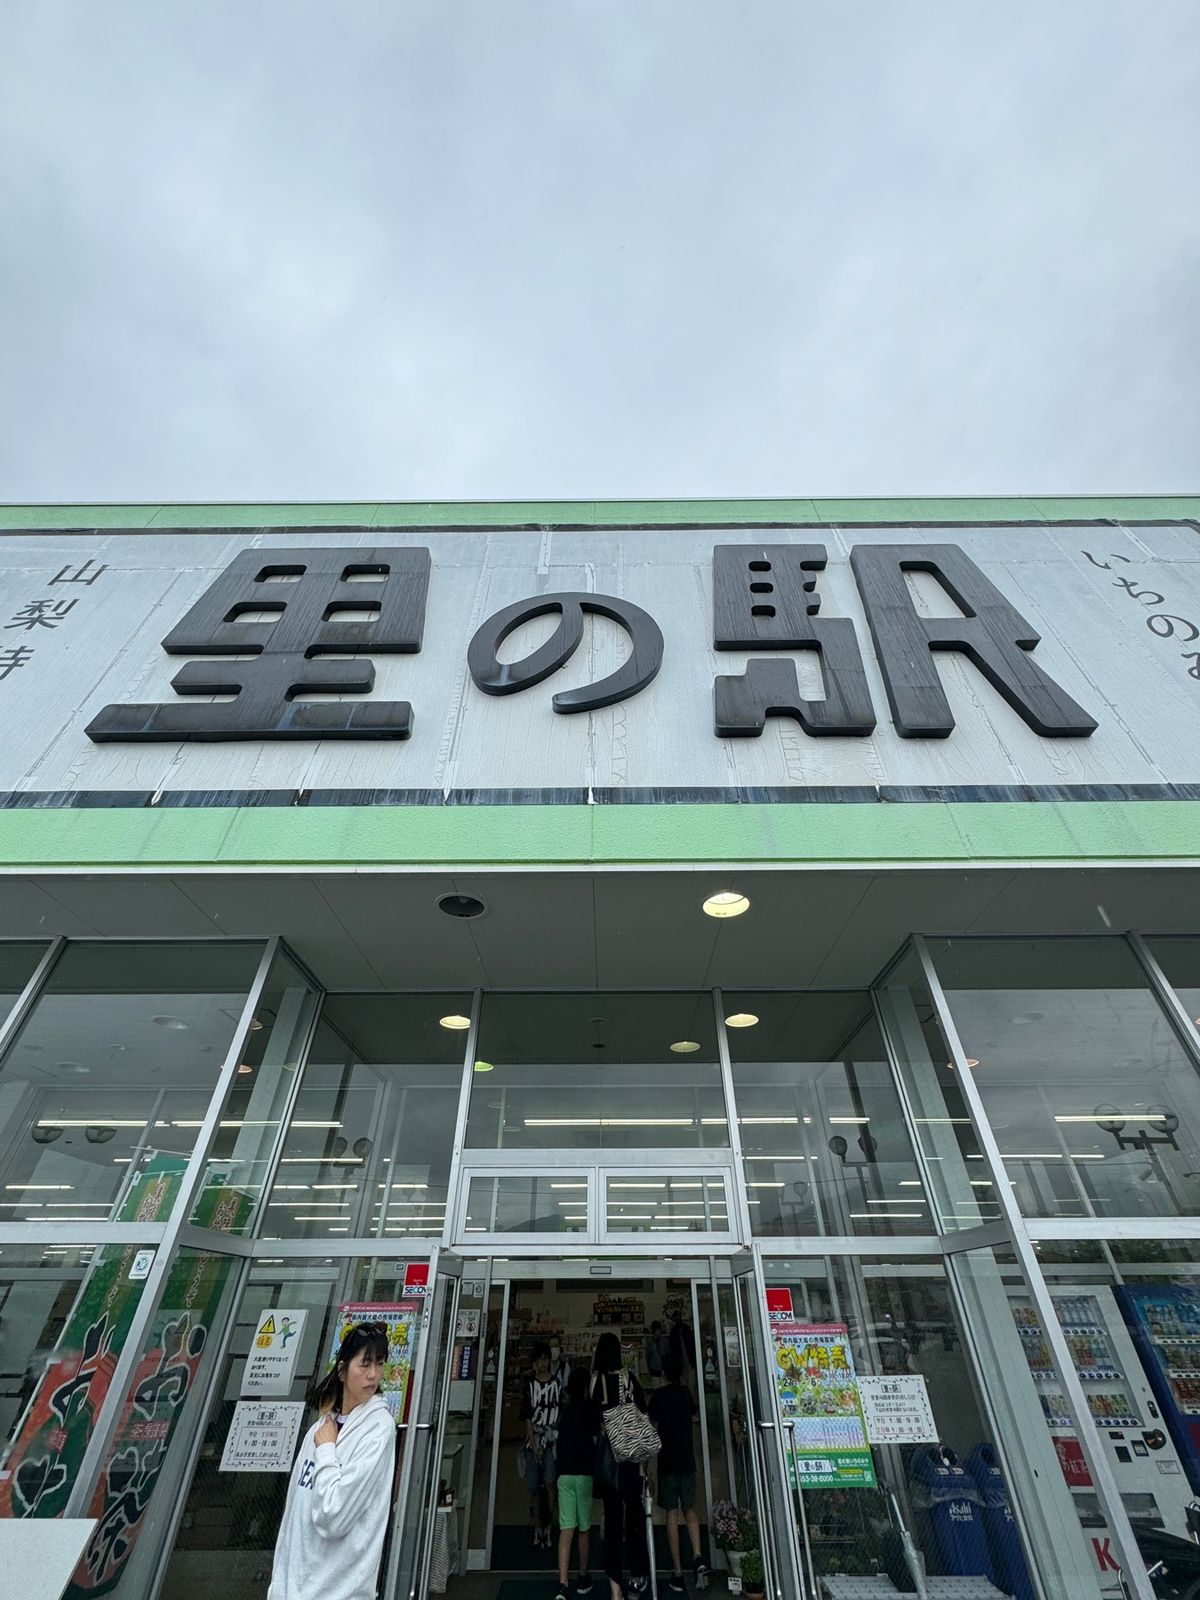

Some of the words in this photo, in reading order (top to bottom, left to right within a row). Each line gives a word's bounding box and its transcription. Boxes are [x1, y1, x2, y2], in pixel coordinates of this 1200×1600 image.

[84, 544, 1098, 743] 里の駅
[768, 1312, 793, 1320] SECOM
[949, 1501, 972, 1514] Asahi
